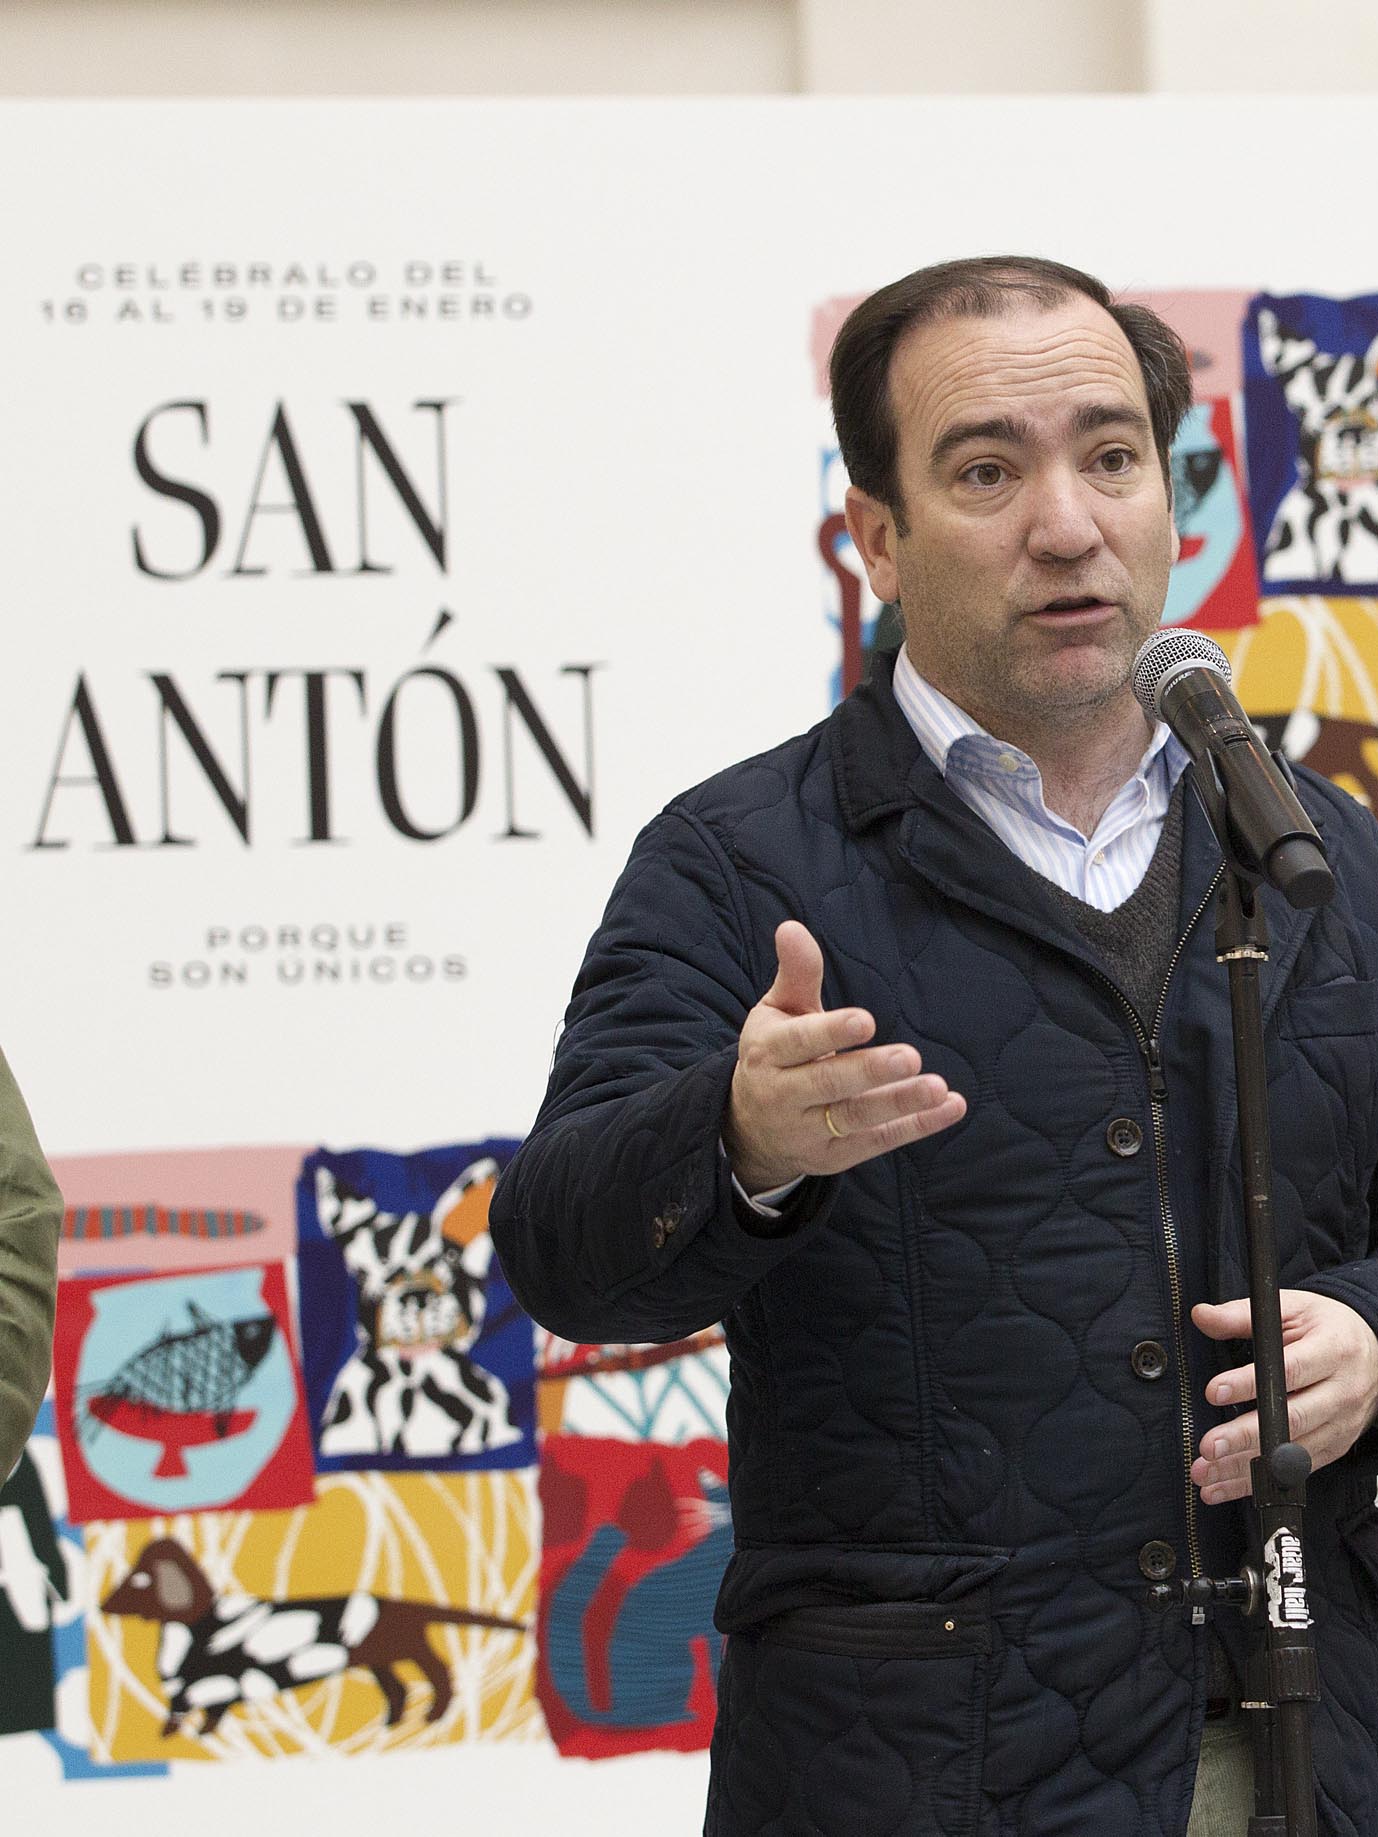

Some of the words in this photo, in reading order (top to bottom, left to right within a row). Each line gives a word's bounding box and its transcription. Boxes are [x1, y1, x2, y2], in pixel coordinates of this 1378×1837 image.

[404, 259, 497, 287] DEL
[43, 298, 88, 325] 16
[116, 297, 174, 325] AL
[202, 297, 249, 323] 19
[277, 294, 336, 322] DE
[367, 291, 533, 321] ENERO
[129, 396, 461, 582] SAN
[1164, 671, 1193, 696] SHURE
[25, 606, 606, 852] ANTÓN
[206, 921, 408, 952] PORQUE
[149, 959, 247, 989] SON
